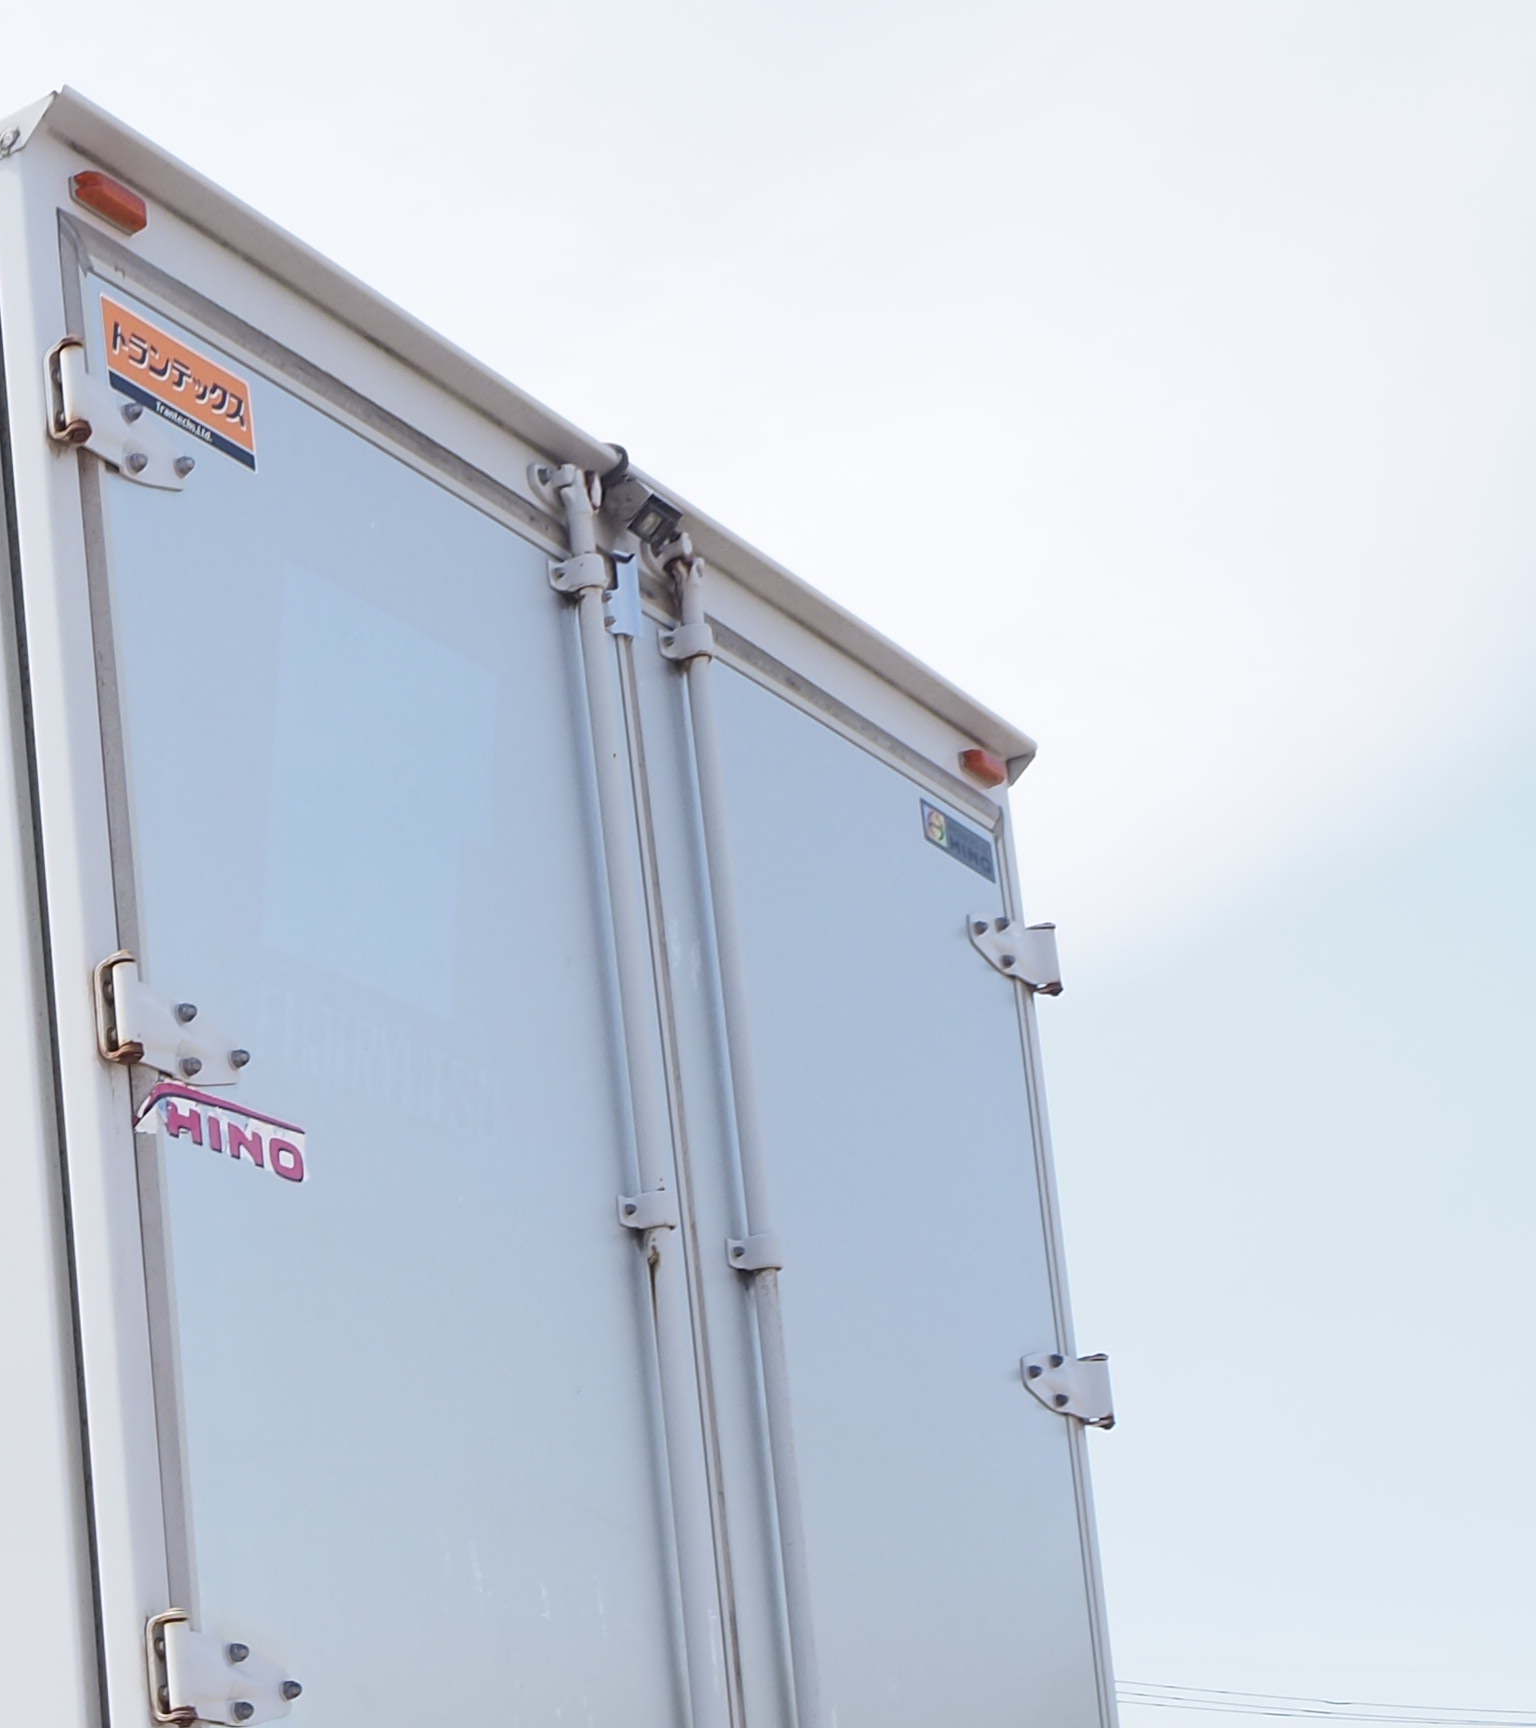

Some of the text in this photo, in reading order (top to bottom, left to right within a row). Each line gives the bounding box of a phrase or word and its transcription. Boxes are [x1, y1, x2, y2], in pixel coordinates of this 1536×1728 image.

[112, 321, 246, 431] トランテックス
[166, 1100, 305, 1182] HINO
